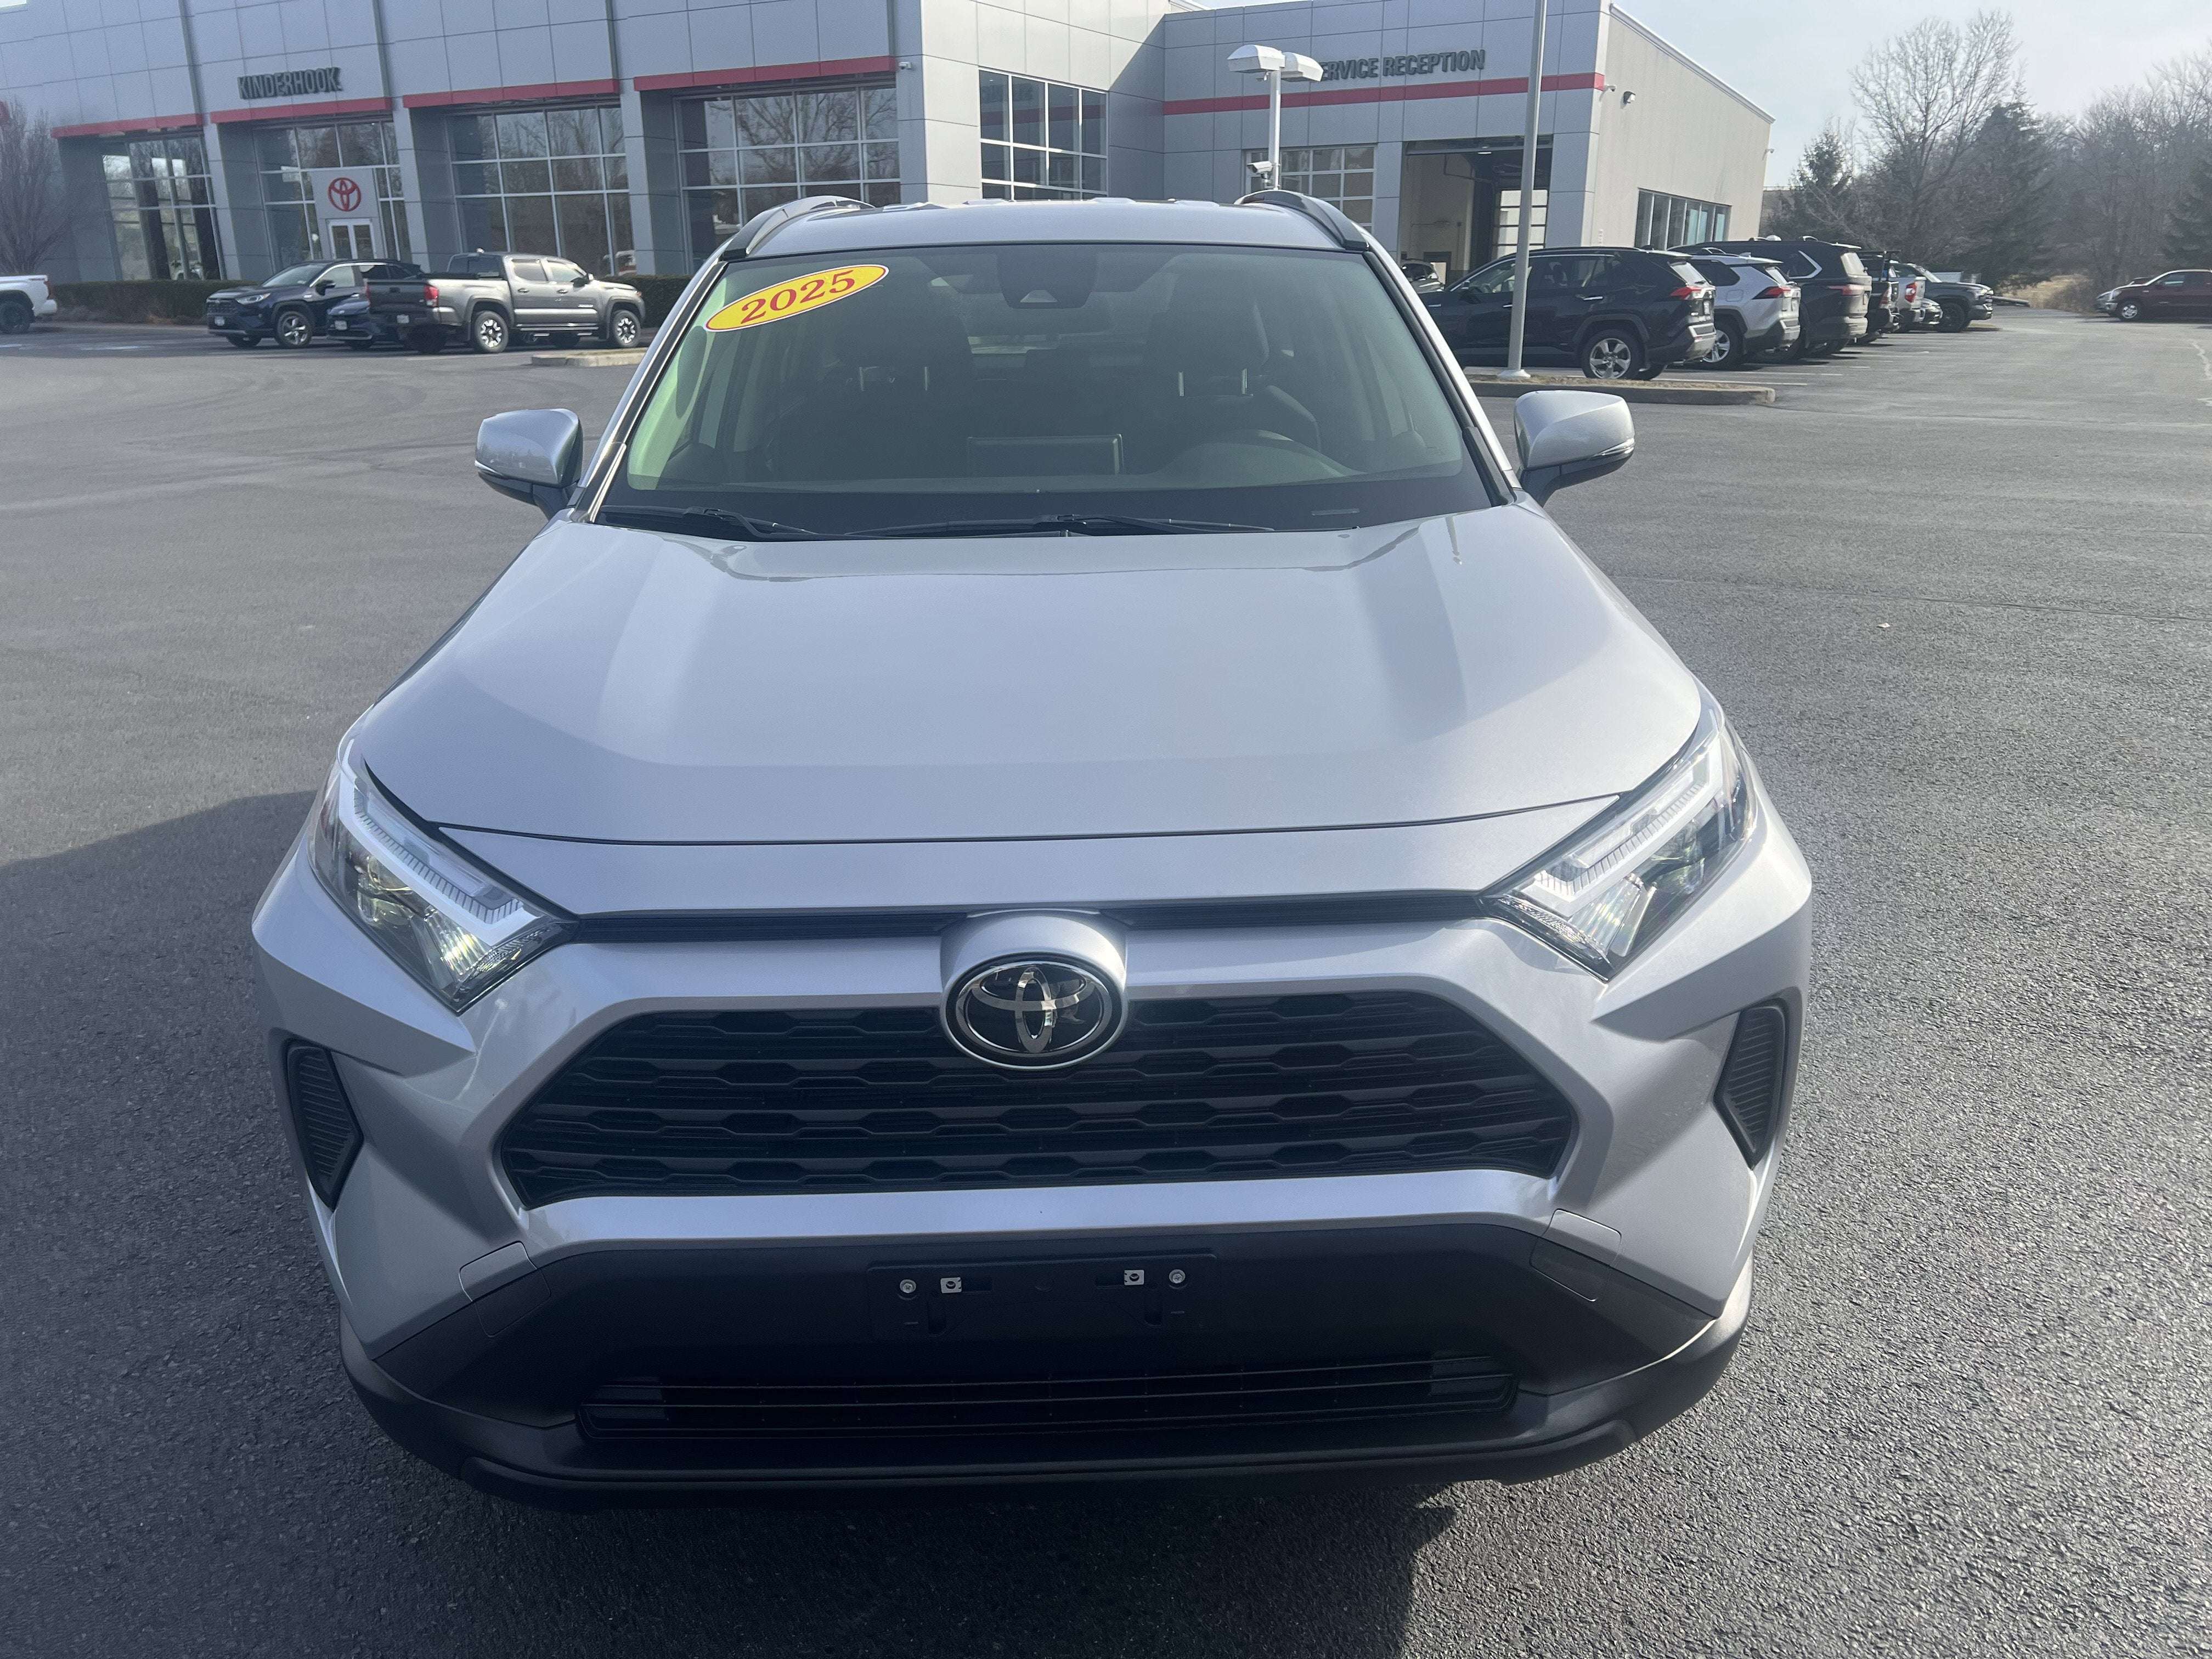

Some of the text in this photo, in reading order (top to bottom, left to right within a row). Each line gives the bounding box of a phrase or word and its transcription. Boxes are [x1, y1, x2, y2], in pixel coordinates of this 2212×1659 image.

[1318, 49, 1486, 81] ERVICE RECEPTION
[237, 67, 341, 99] KINDERHOOK
[741, 270, 855, 324] 2025
